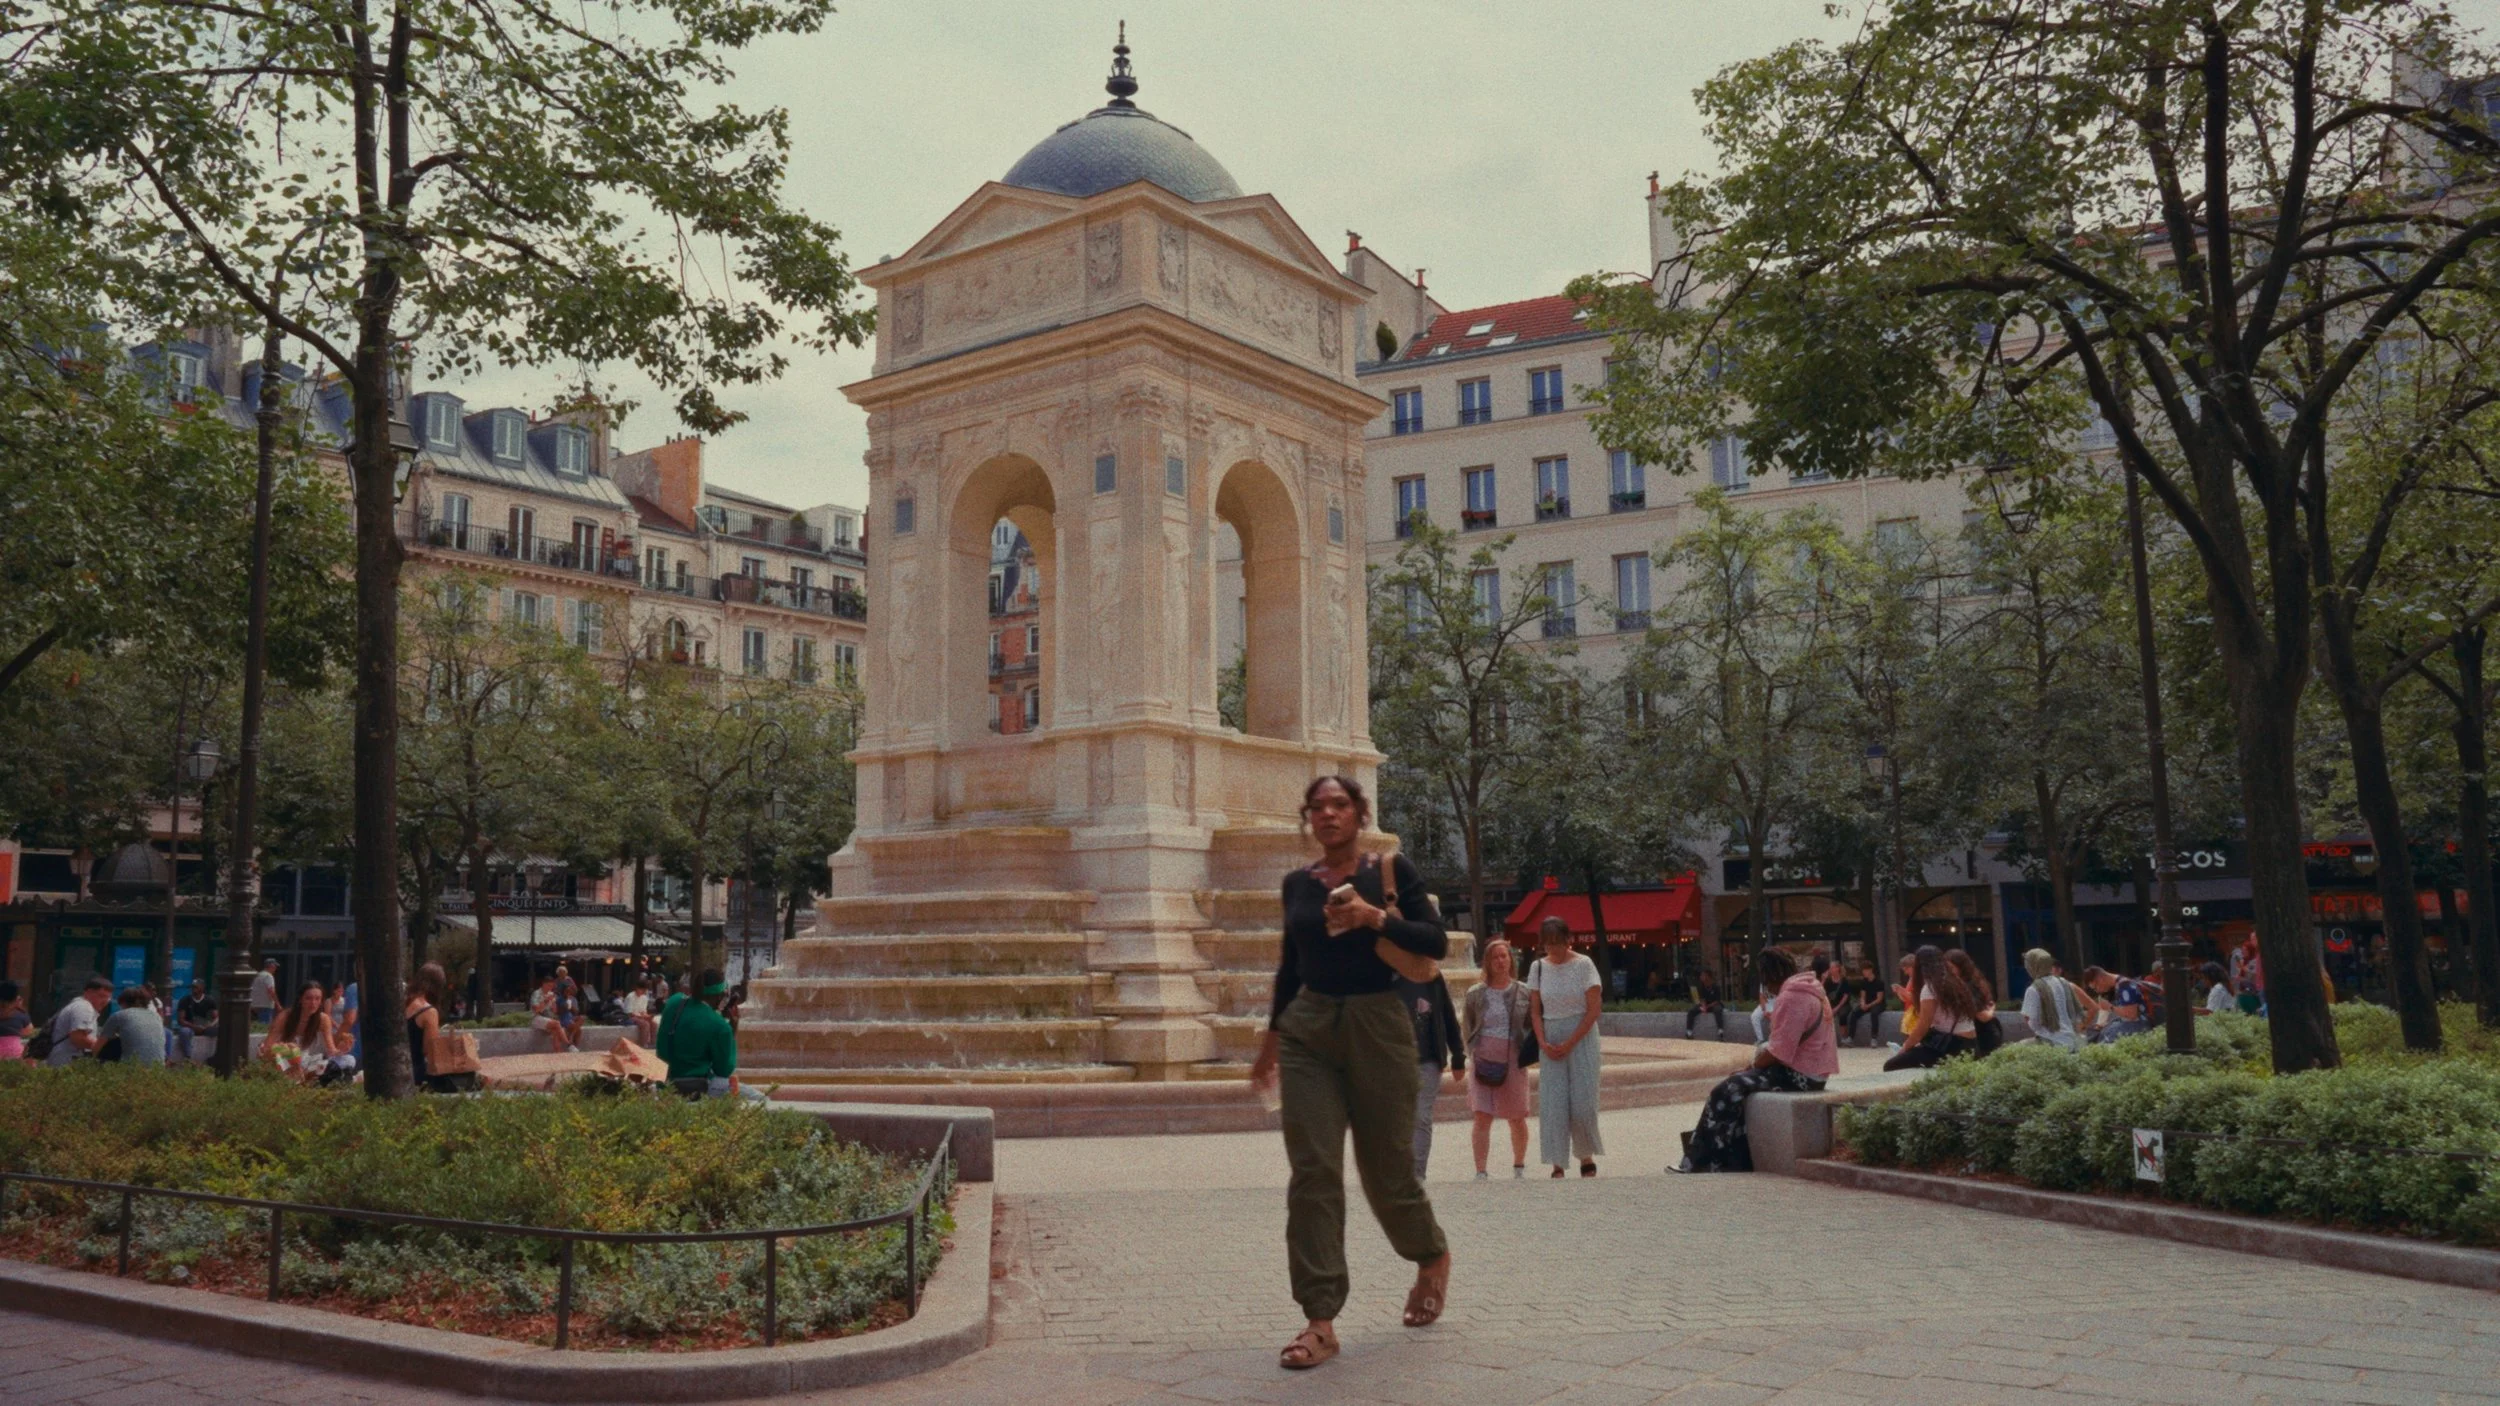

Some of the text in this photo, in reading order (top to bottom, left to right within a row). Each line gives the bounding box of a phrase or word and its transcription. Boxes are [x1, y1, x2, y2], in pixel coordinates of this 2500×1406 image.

[2145, 850, 2227, 869] TCOS
[488, 899, 569, 910] INQUECENTO
[1578, 933, 1637, 943] RESURANT
